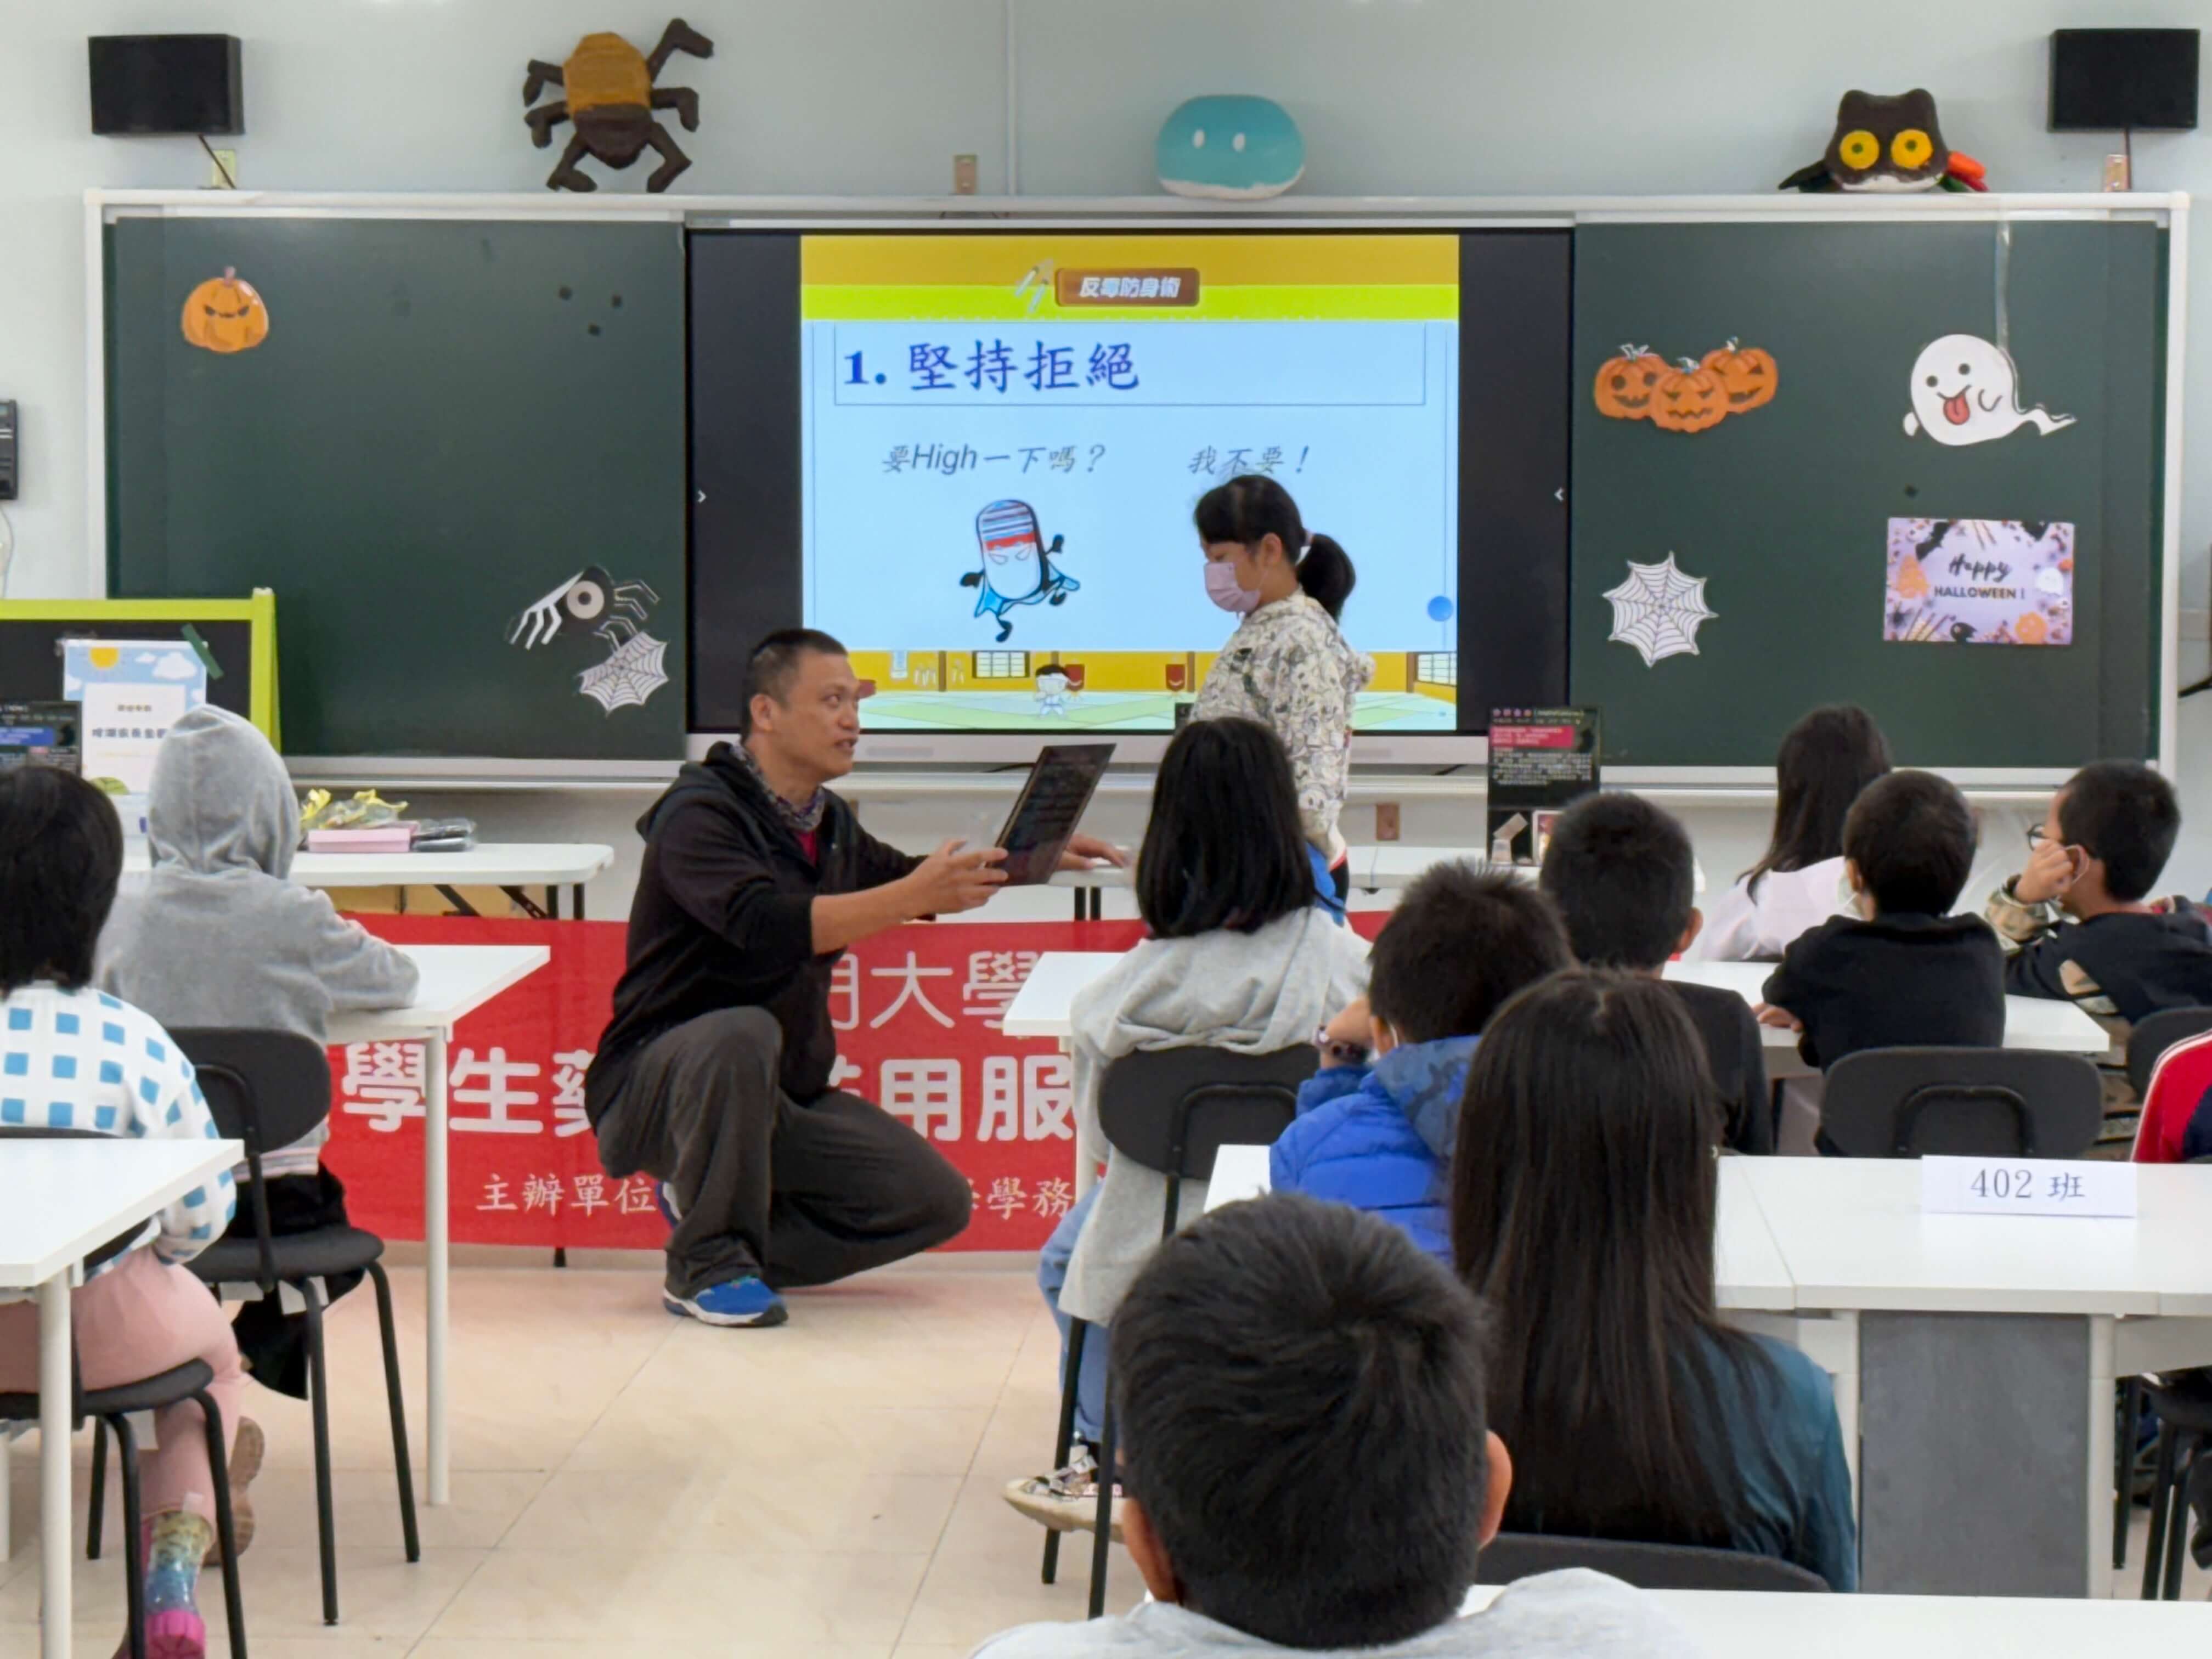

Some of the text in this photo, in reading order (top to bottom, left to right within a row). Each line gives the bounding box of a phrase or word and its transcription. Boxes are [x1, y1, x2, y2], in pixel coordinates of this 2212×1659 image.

[843, 338, 1140, 394] 1. 堅持拒絕
[1948, 553, 2012, 583] Happy
[1934, 585, 2017, 600] HALLOWEEN
[476, 1172, 657, 1216] 主辦單位
[1970, 1168, 2086, 1202] 402 班
